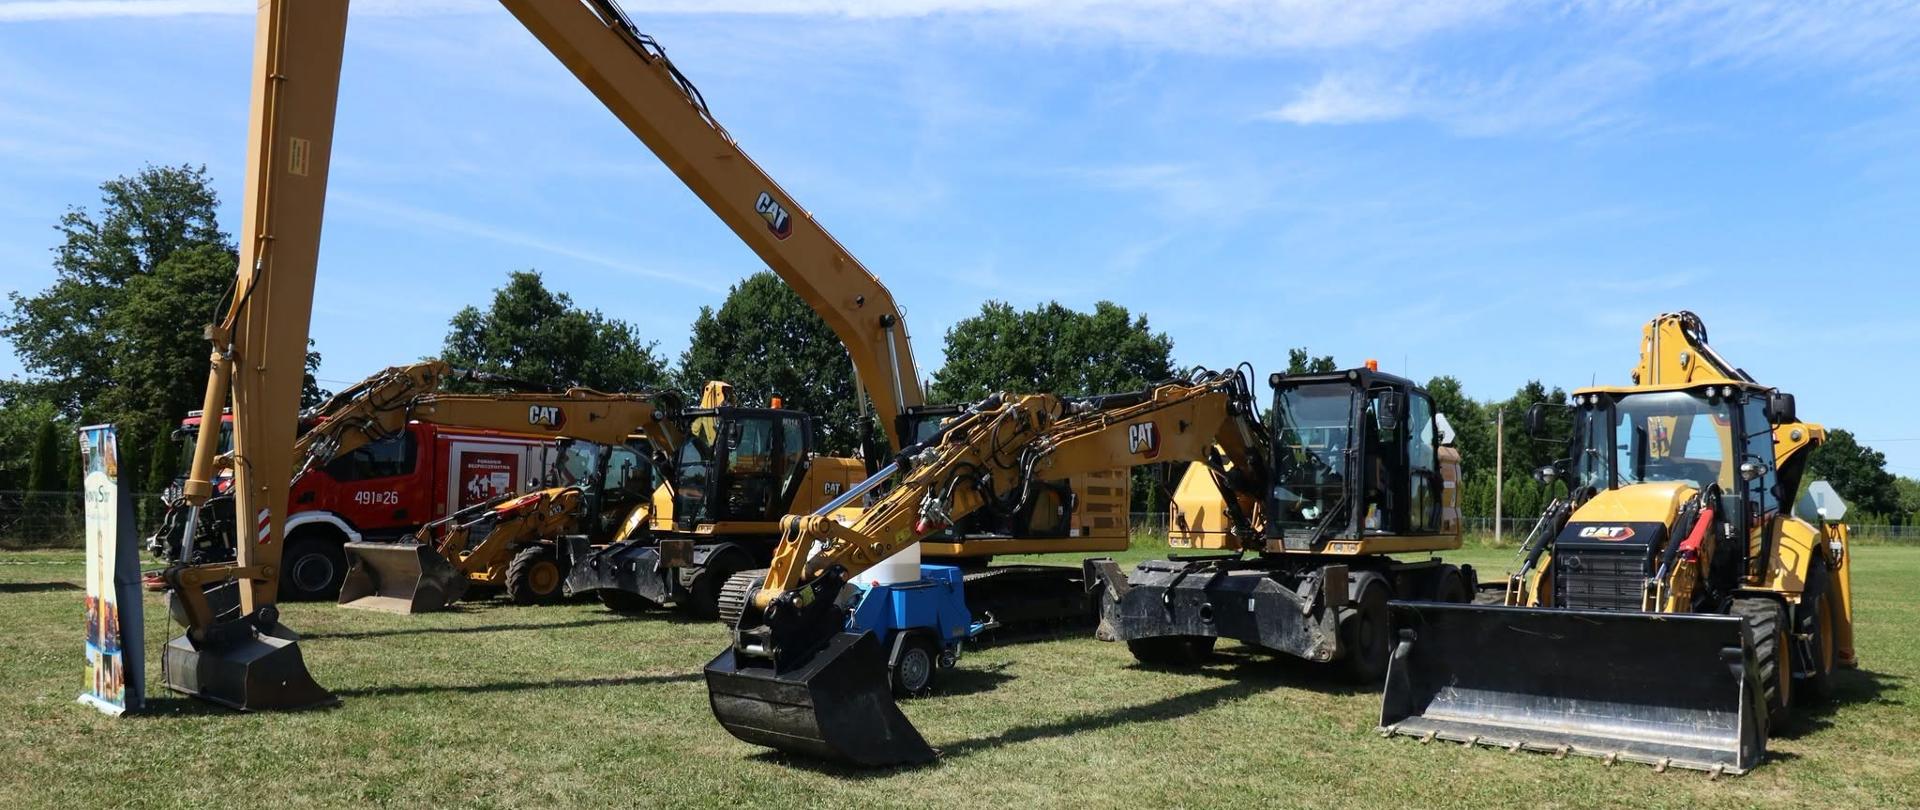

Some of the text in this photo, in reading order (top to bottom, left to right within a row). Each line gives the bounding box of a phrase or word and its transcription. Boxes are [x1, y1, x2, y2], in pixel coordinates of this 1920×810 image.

[755, 191, 789, 230] CAT
[529, 405, 559, 425] CAT
[1129, 422, 1153, 453] CAT
[824, 482, 840, 495] CAT
[1579, 526, 1625, 537] CAT
